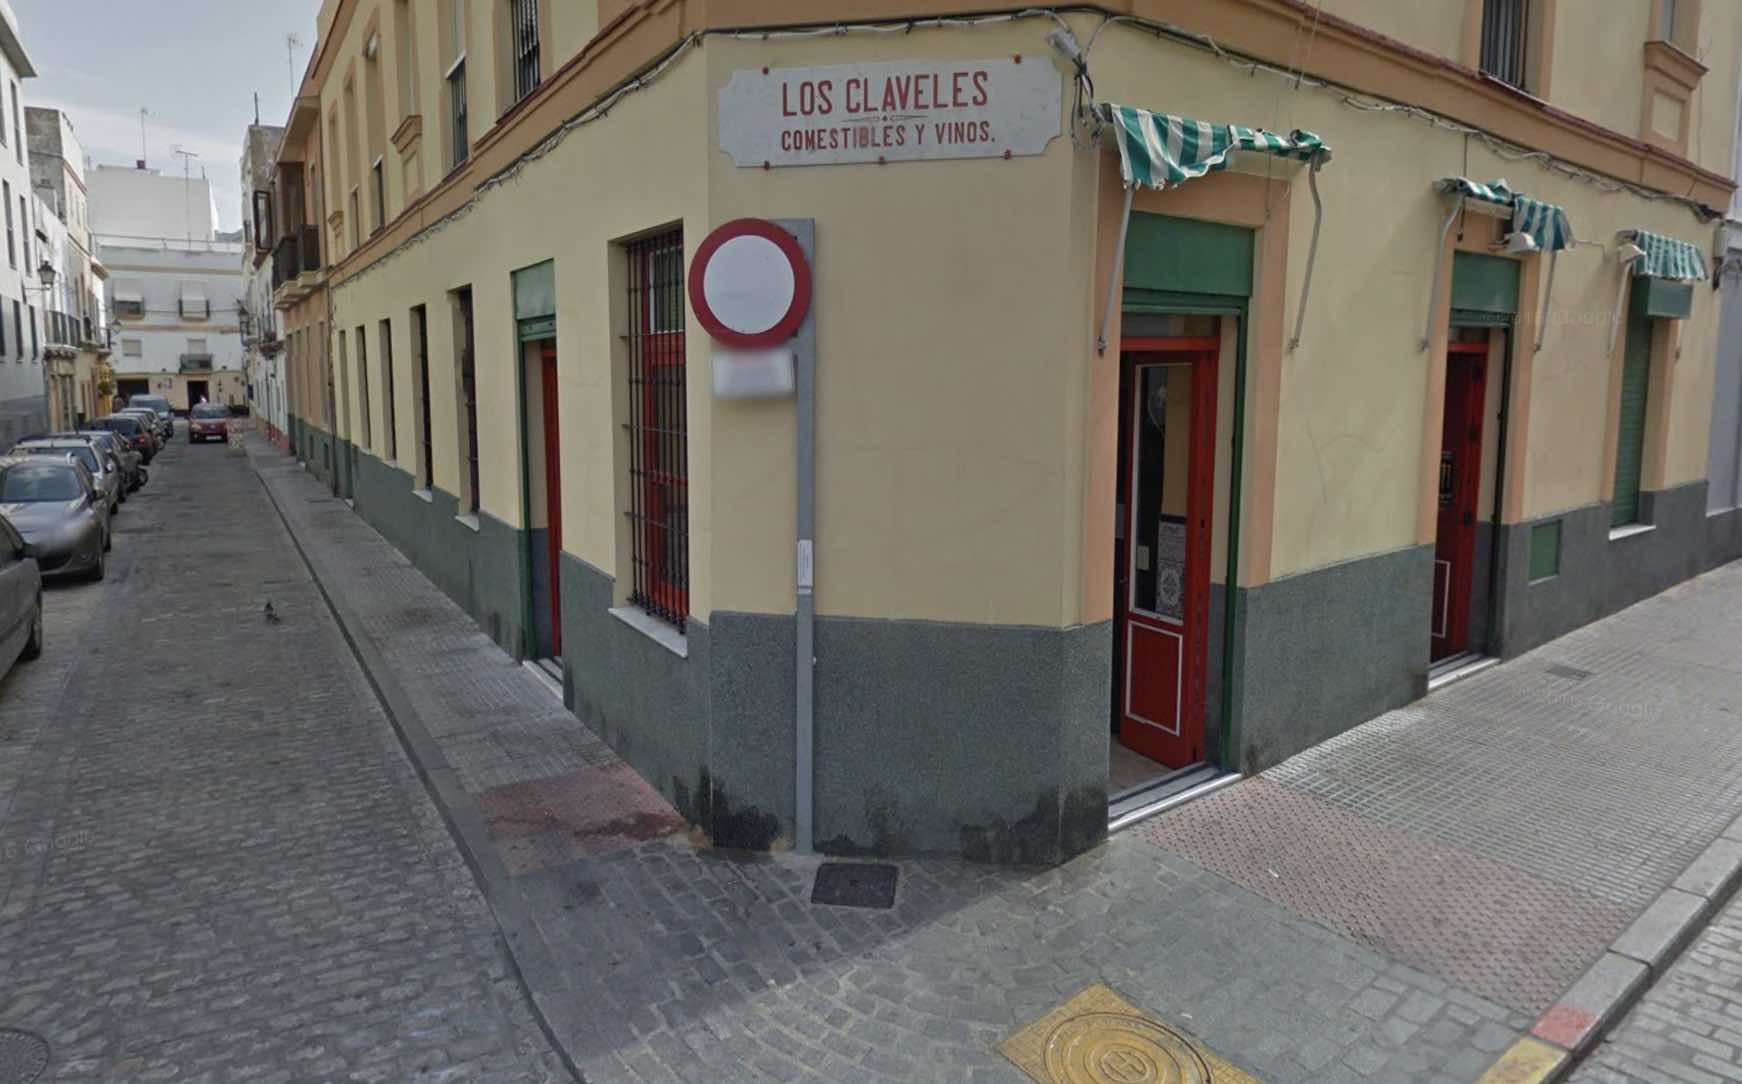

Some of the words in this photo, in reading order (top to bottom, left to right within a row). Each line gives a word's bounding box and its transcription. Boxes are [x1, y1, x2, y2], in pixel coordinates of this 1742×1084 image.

[781, 80, 833, 118] LOS
[845, 70, 989, 113] CLAVELES
[781, 125, 905, 151] COMESTIBLES
[915, 123, 925, 145] Y
[936, 121, 996, 144] VINOS.
